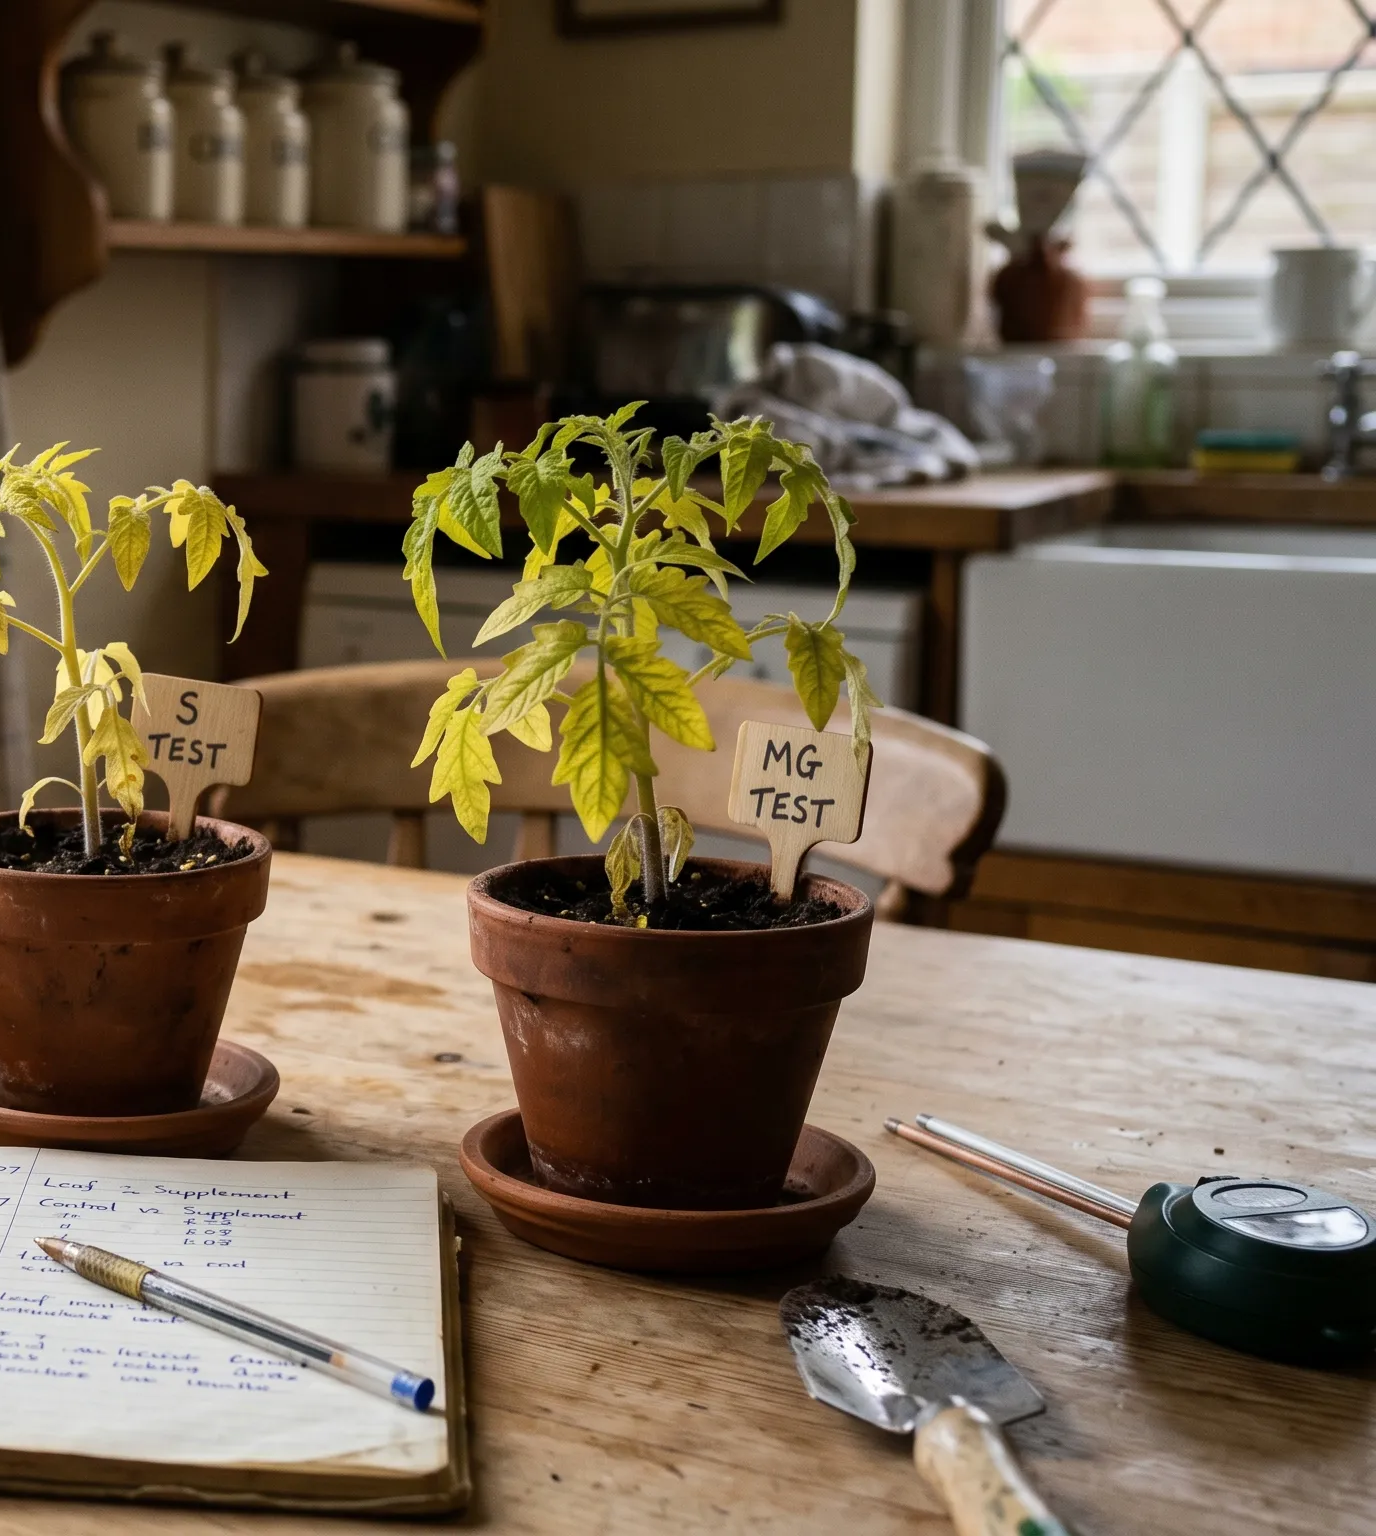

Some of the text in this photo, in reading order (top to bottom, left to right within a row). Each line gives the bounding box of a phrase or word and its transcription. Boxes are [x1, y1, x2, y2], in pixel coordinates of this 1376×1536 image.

[175, 691, 199, 726] S
[147, 733, 227, 769] TEST
[762, 739, 823, 781] MG
[749, 787, 835, 828] TEST
[39, 1198, 117, 1212] Control
[183, 1206, 308, 1221] Supplement
[154, 1184, 296, 1201] Supplement
